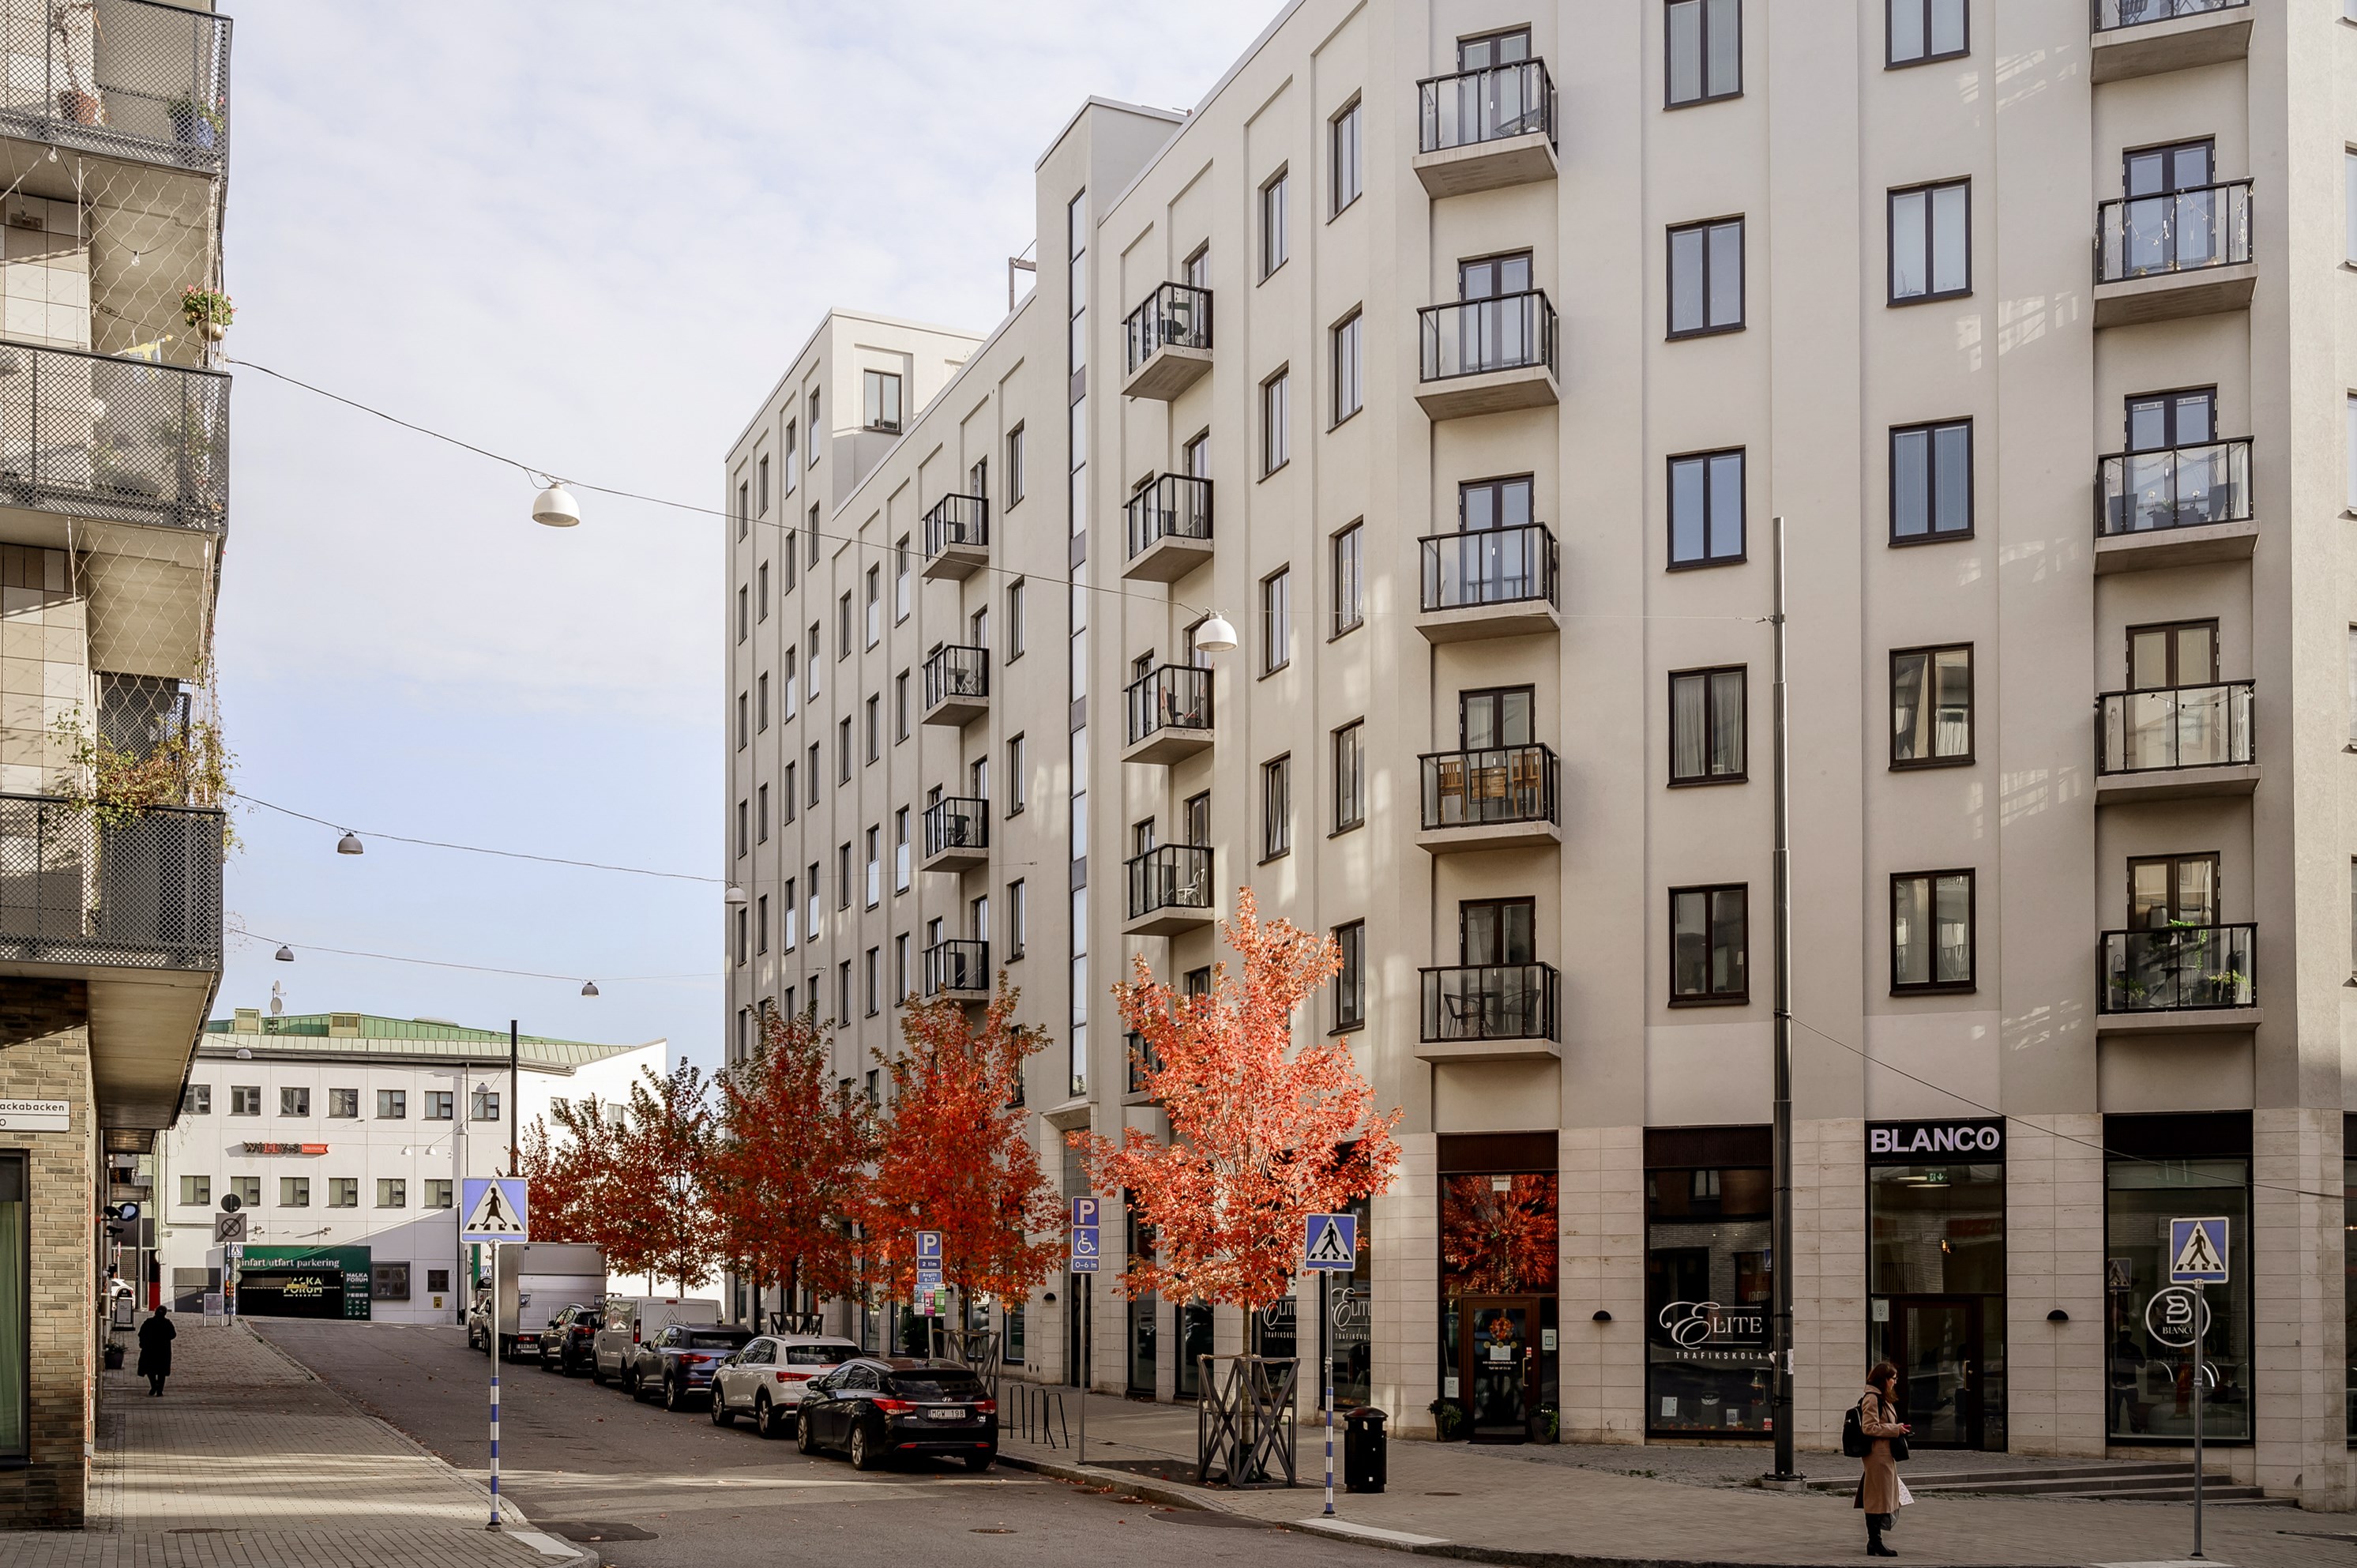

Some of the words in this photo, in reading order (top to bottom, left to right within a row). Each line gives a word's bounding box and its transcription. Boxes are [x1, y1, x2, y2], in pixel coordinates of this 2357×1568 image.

[1870, 1126, 2000, 1152] BLANCO
[1080, 1199, 1096, 1224] P
[923, 1234, 938, 1254] P
[296, 1258, 340, 1269] parkering
